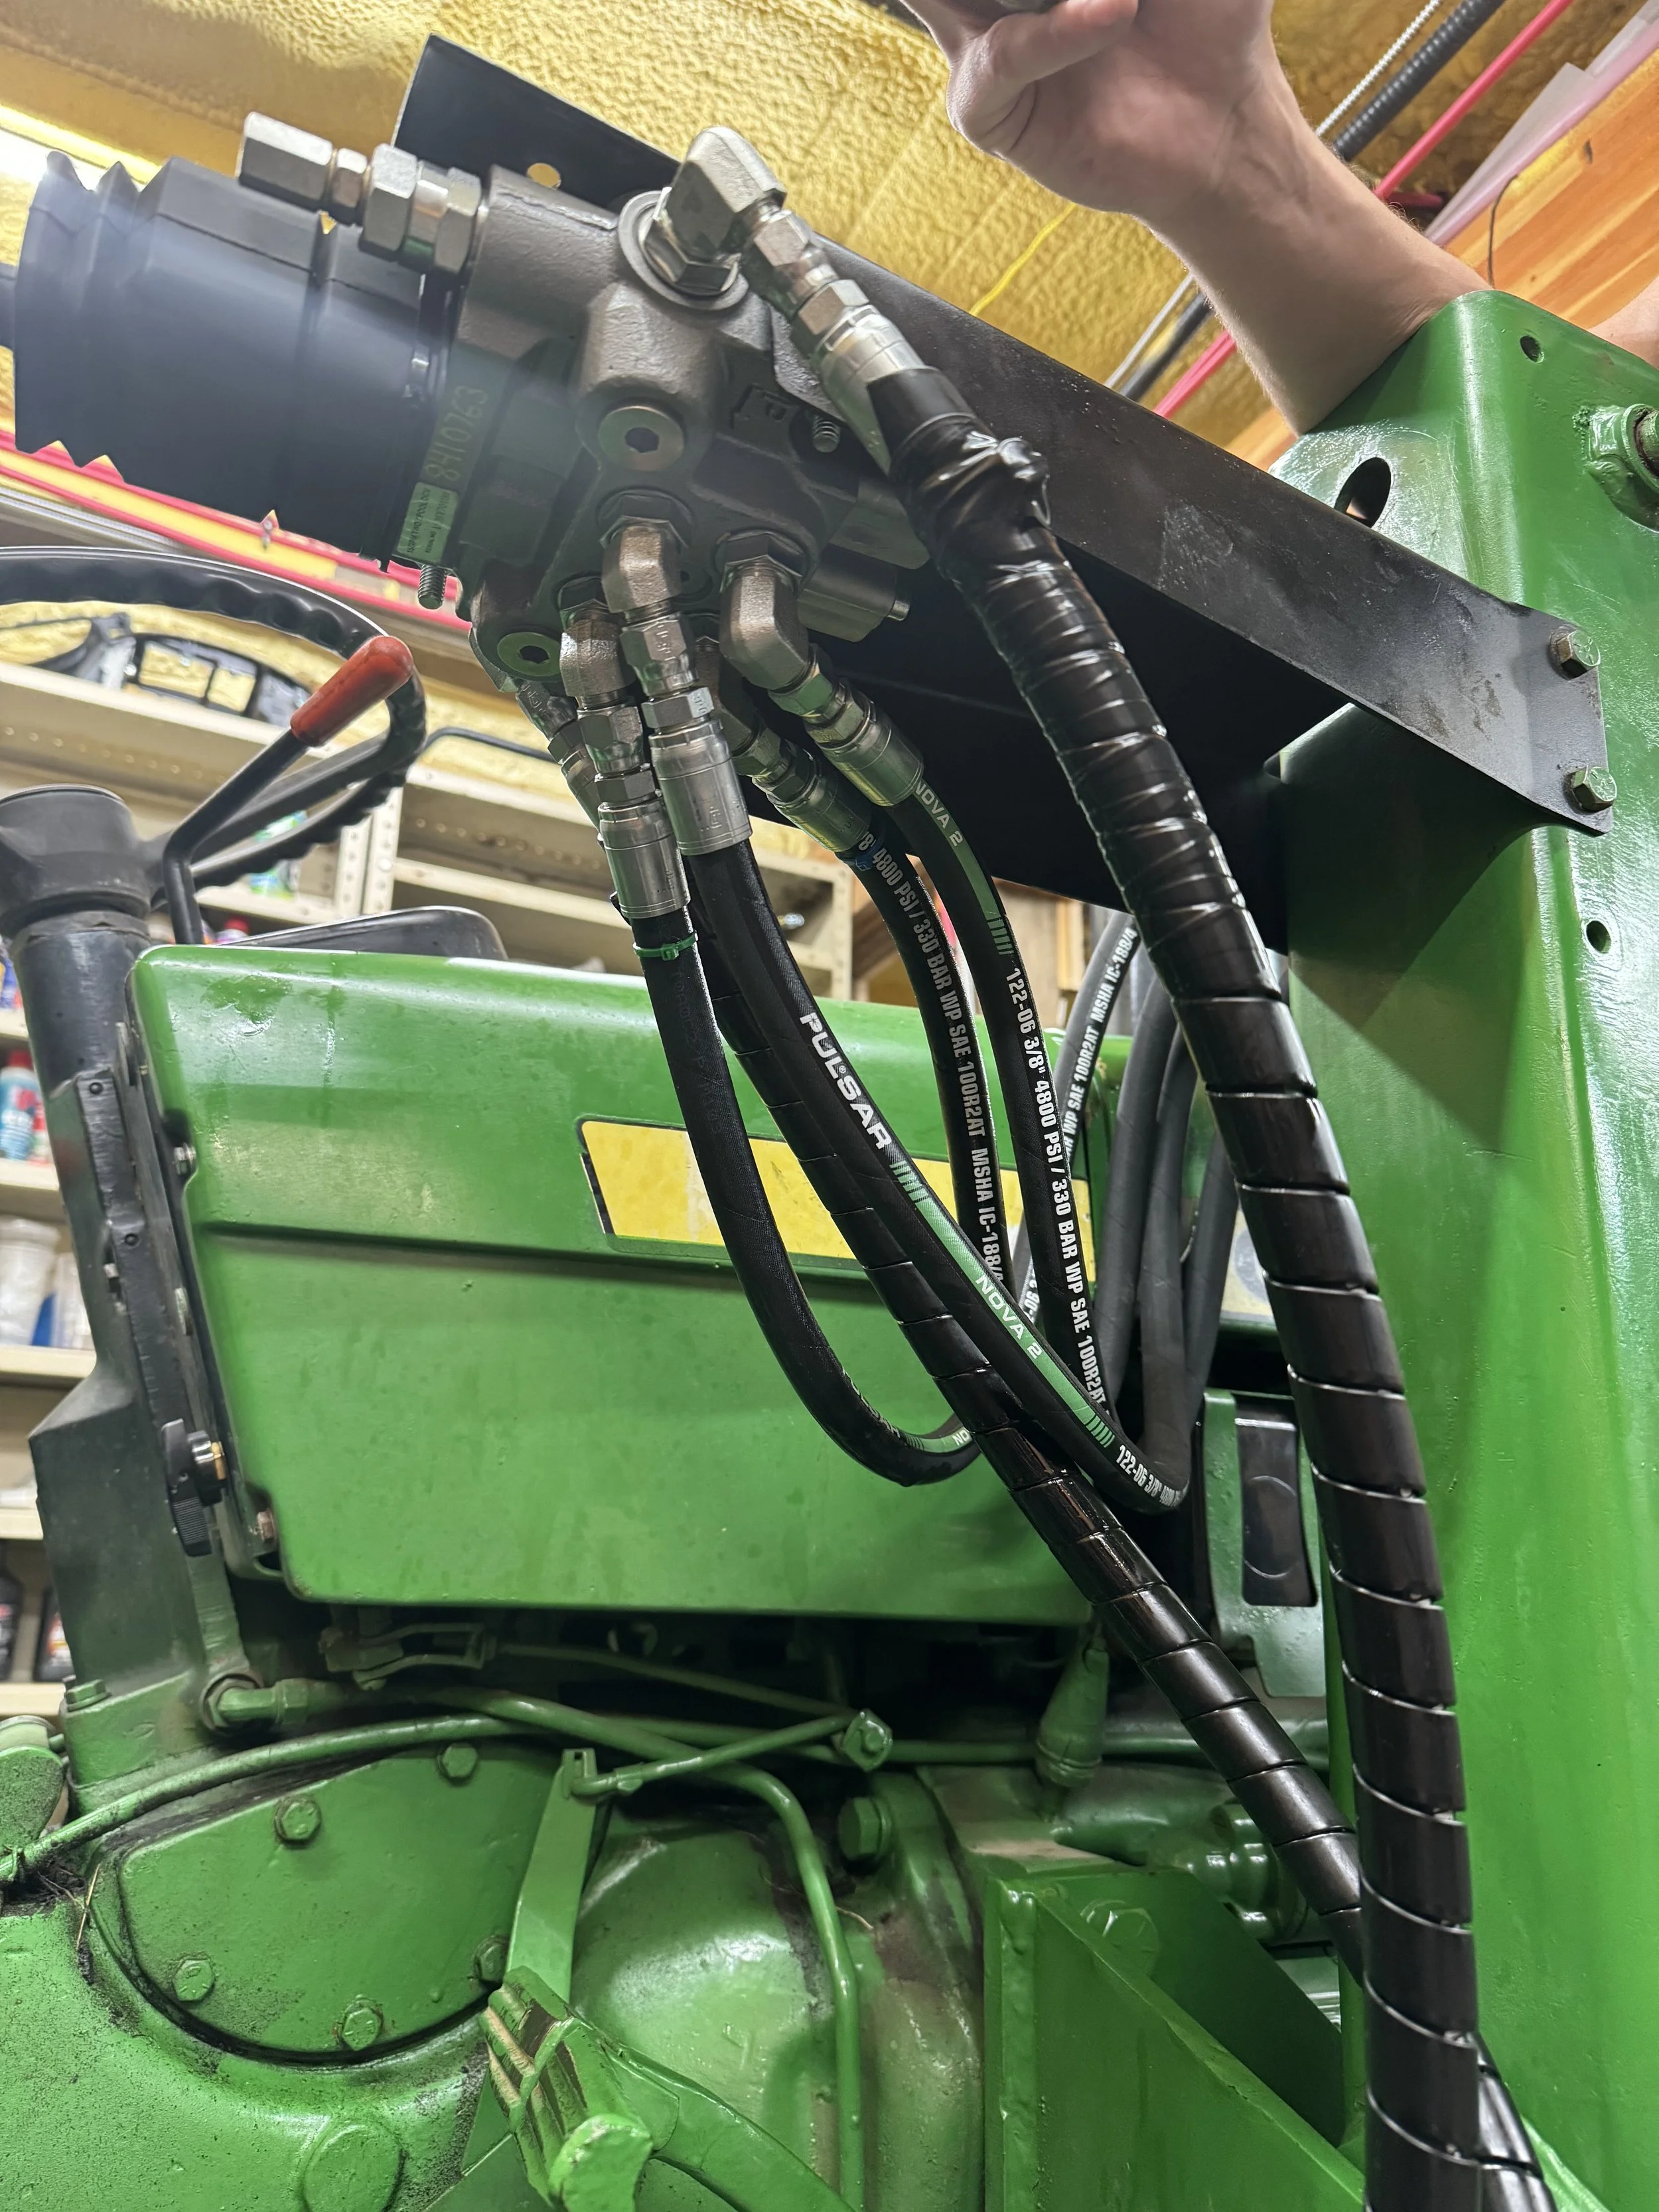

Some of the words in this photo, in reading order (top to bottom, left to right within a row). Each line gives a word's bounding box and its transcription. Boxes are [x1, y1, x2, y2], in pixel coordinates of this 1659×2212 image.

[949, 830, 963, 847] 2
[873, 848, 904, 886] 4800
[894, 881, 920, 912] PSI
[908, 910, 926, 919] /
[913, 919, 937, 952] 330
[927, 952, 952, 990] BAR
[939, 991, 962, 1021] WP
[1005, 968, 1036, 1034] 122-06
[1090, 982, 1116, 1023] MSHA
[949, 1024, 972, 1057] SAE
[1024, 1036, 1046, 1074] 3/8"
[1074, 1026, 1100, 1082] 100R2AT
[958, 1061, 985, 1136] 100R2AT
[1035, 1080, 1056, 1128] 4800
[1067, 1083, 1086, 1111] SAE
[1044, 1130, 1063, 1163] PSI
[971, 1147, 993, 1203] MSHA
[1052, 1178, 1071, 1217] 330
[1058, 1219, 1079, 1260] BAR
[1064, 1260, 1084, 1294] WP
[975, 1276, 1025, 1340] NOVA
[1027, 1342, 1043, 1359] 2
[1070, 1297, 1090, 1333] SAE
[1077, 1335, 1106, 1404] 100R2AT
[1116, 1444, 1148, 1487] 122-06
